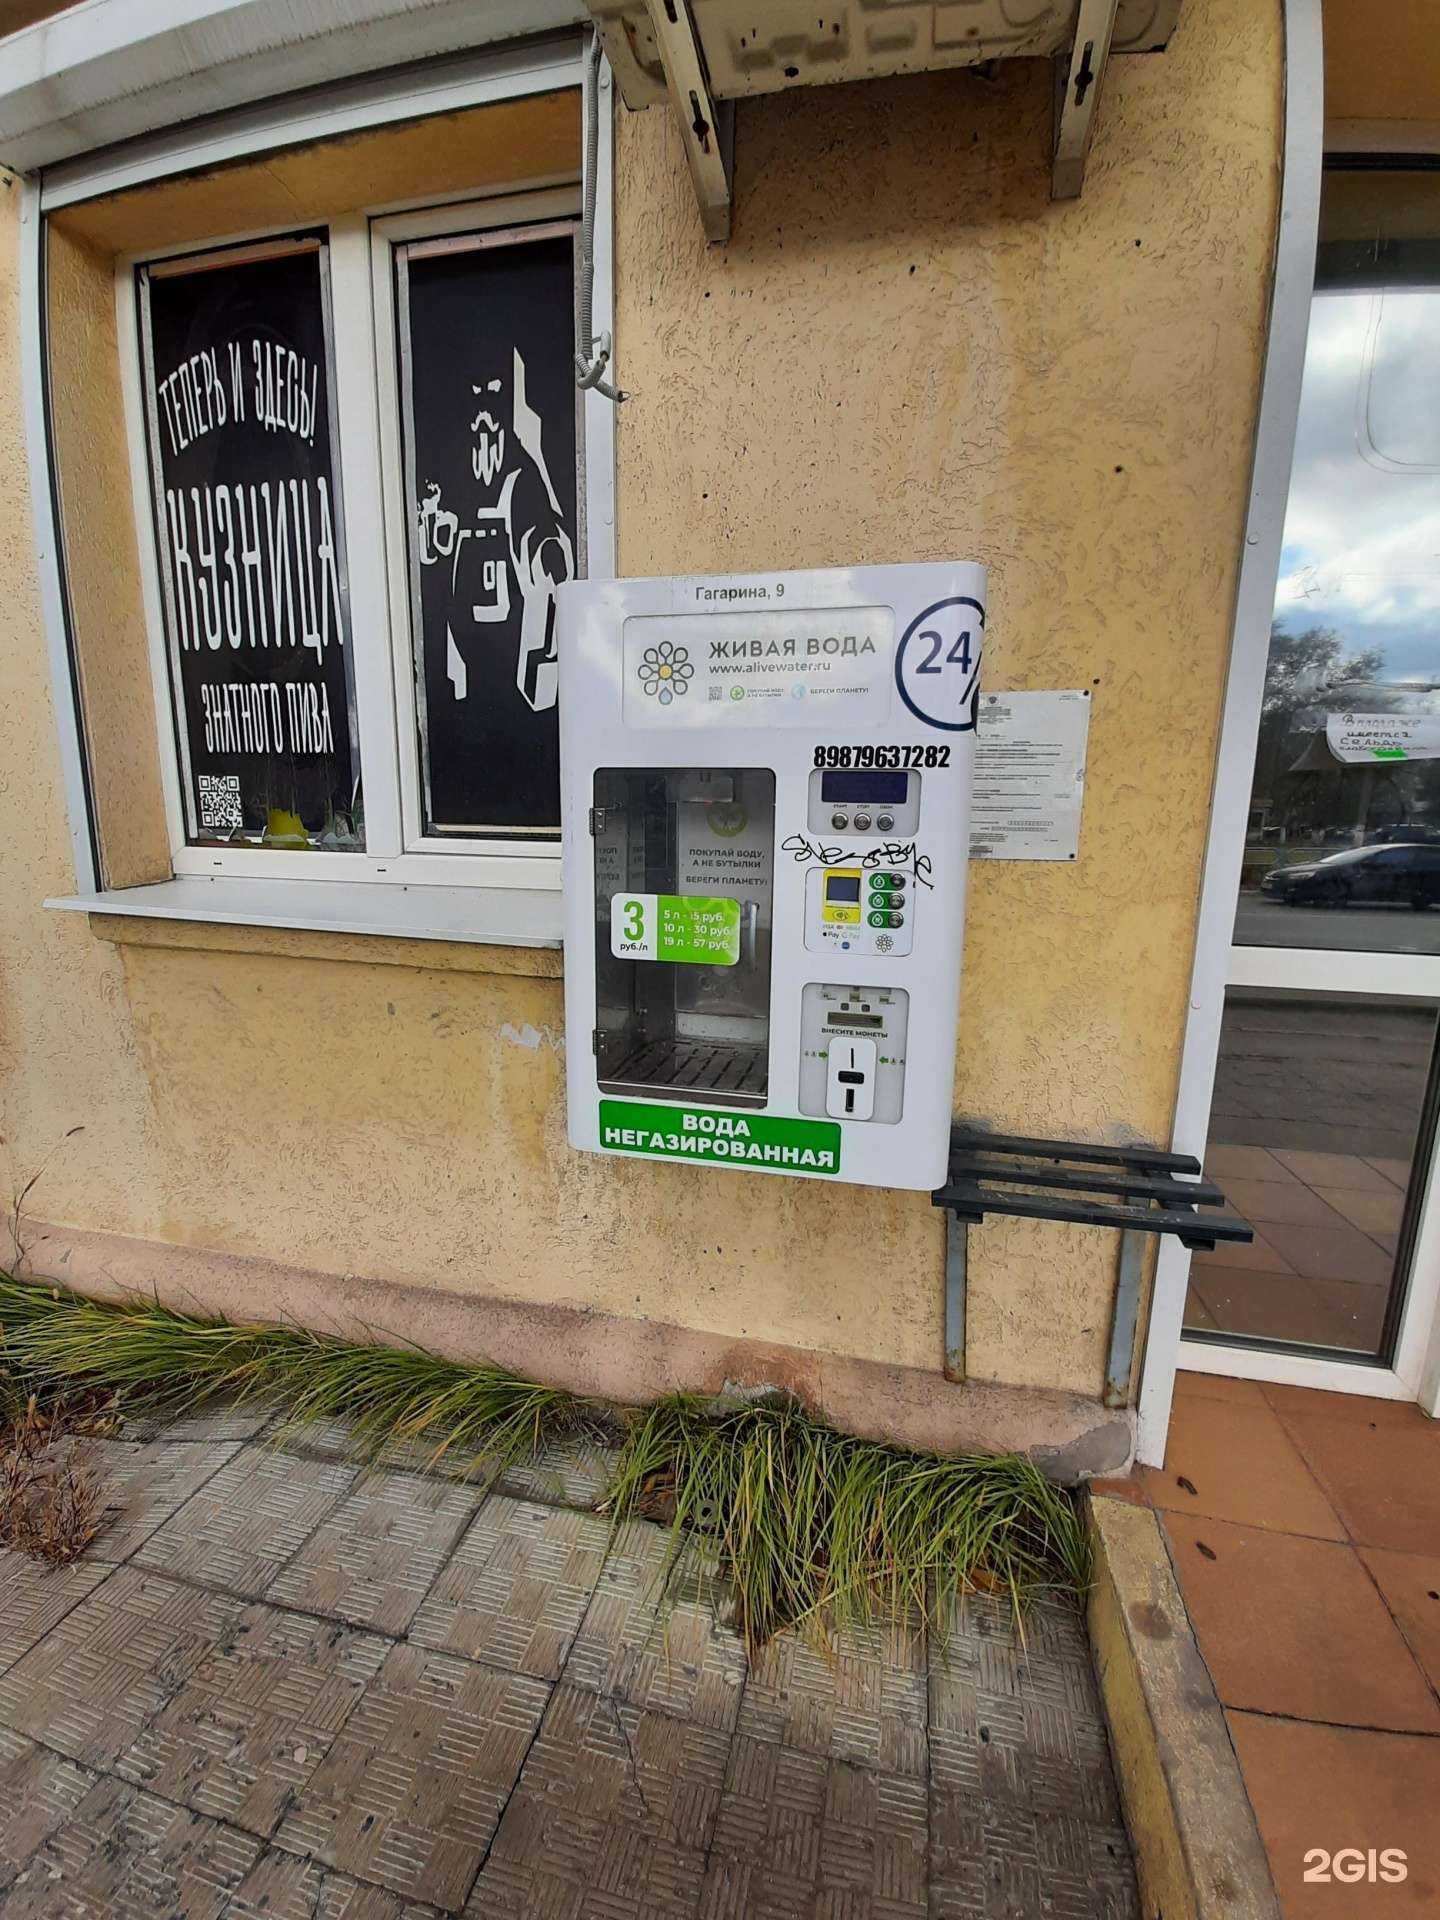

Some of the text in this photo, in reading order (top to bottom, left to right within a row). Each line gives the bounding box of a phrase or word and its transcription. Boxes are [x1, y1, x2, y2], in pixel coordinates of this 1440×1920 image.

[159, 339, 318, 456] ТЕПЕРЬ И ЗДЕСЬ!
[166, 476, 345, 666] КУЗНИЦА
[695, 583, 785, 603] Гагарина, 9
[708, 636, 877, 660] ЖИВАЯ ВОДА
[708, 661, 832, 675] www.alivewater.ru
[201, 681, 335, 754] ЗНАТНОГО ПИВА
[813, 745, 950, 768] 89879637282
[689, 848, 765, 859] ПОКУПАЙ ВОДУ,
[715, 860, 761, 868] БУТЫЛКИ
[686, 875, 719, 884] БЕРЕГИ
[623, 900, 644, 941] 3
[664, 910, 671, 919] 5
[664, 923, 675, 933] 10
[677, 925, 684, 933] л
[694, 925, 707, 934] 30
[620, 943, 648, 951] руб./л
[664, 936, 674, 946] 19
[676, 938, 684, 946] л
[693, 939, 706, 948] 57
[821, 1027, 888, 1038] ВНЕСИТЕ МОНЕТЫ
[682, 1114, 751, 1137] ВОДА
[605, 1127, 834, 1168] НЕГАЗИРОВАННАЯ
